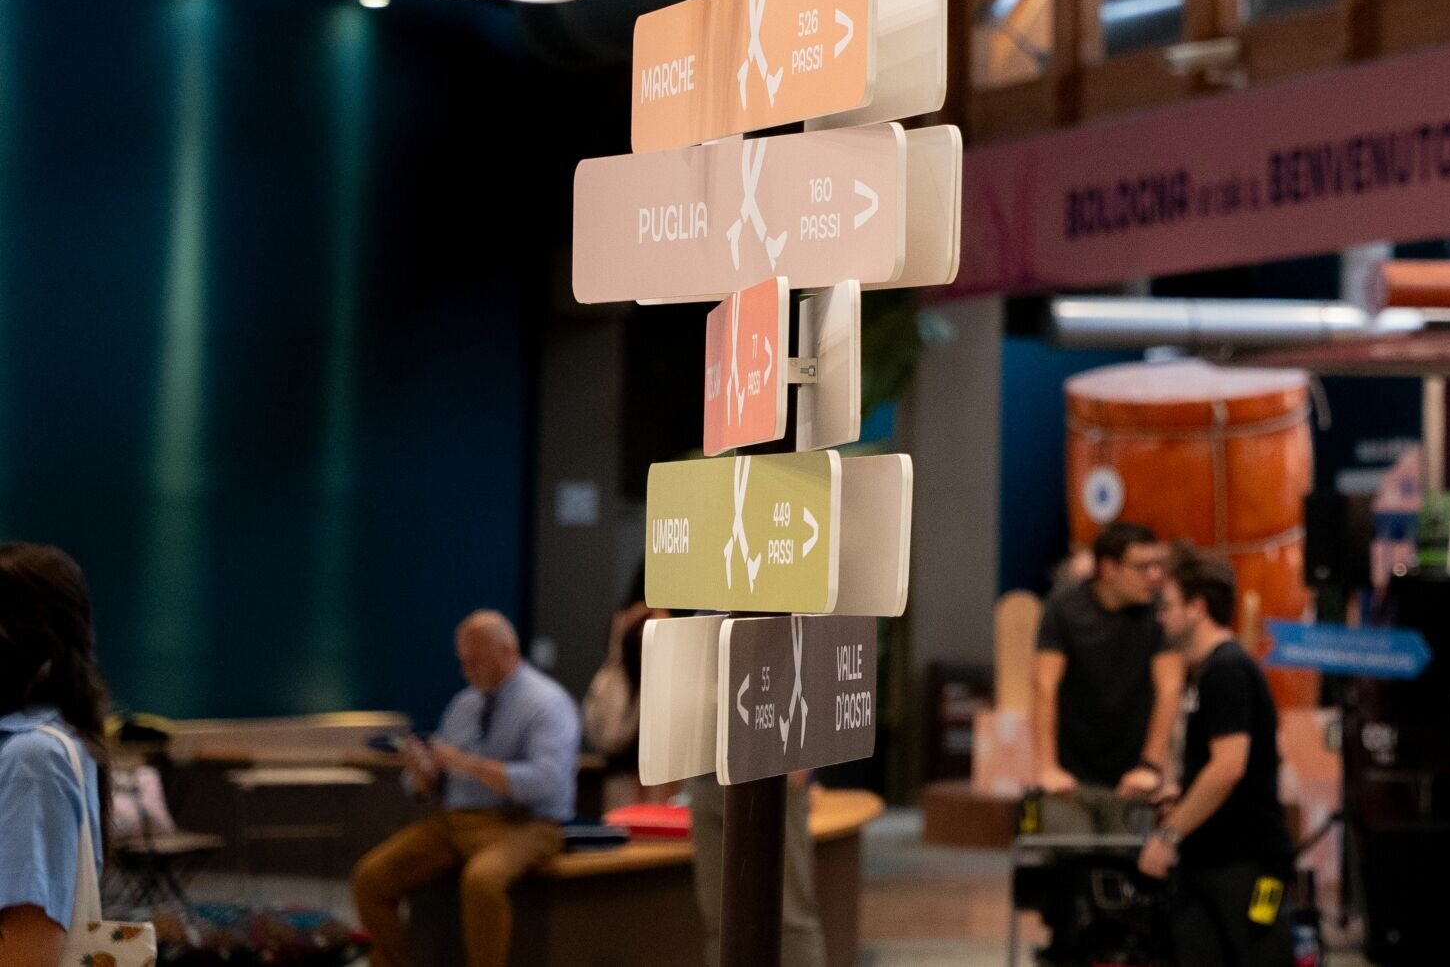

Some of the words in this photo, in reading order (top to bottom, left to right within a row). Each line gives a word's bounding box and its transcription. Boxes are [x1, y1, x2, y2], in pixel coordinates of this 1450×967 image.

[797, 8, 819, 38] 526
[791, 43, 823, 75] PASSI
[640, 54, 695, 105] MARCHE
[808, 177, 833, 204] 160
[638, 201, 708, 244] PUGLIA
[799, 212, 841, 242] PASSI
[747, 370, 761, 396] PASSI
[772, 501, 791, 528] 449
[652, 517, 690, 555] UMBRIA
[767, 537, 794, 566] PASSI
[836, 643, 863, 682] VALLE
[761, 666, 771, 693] 55
[754, 702, 776, 731] PASSI
[835, 691, 872, 732] D'AOSTA
